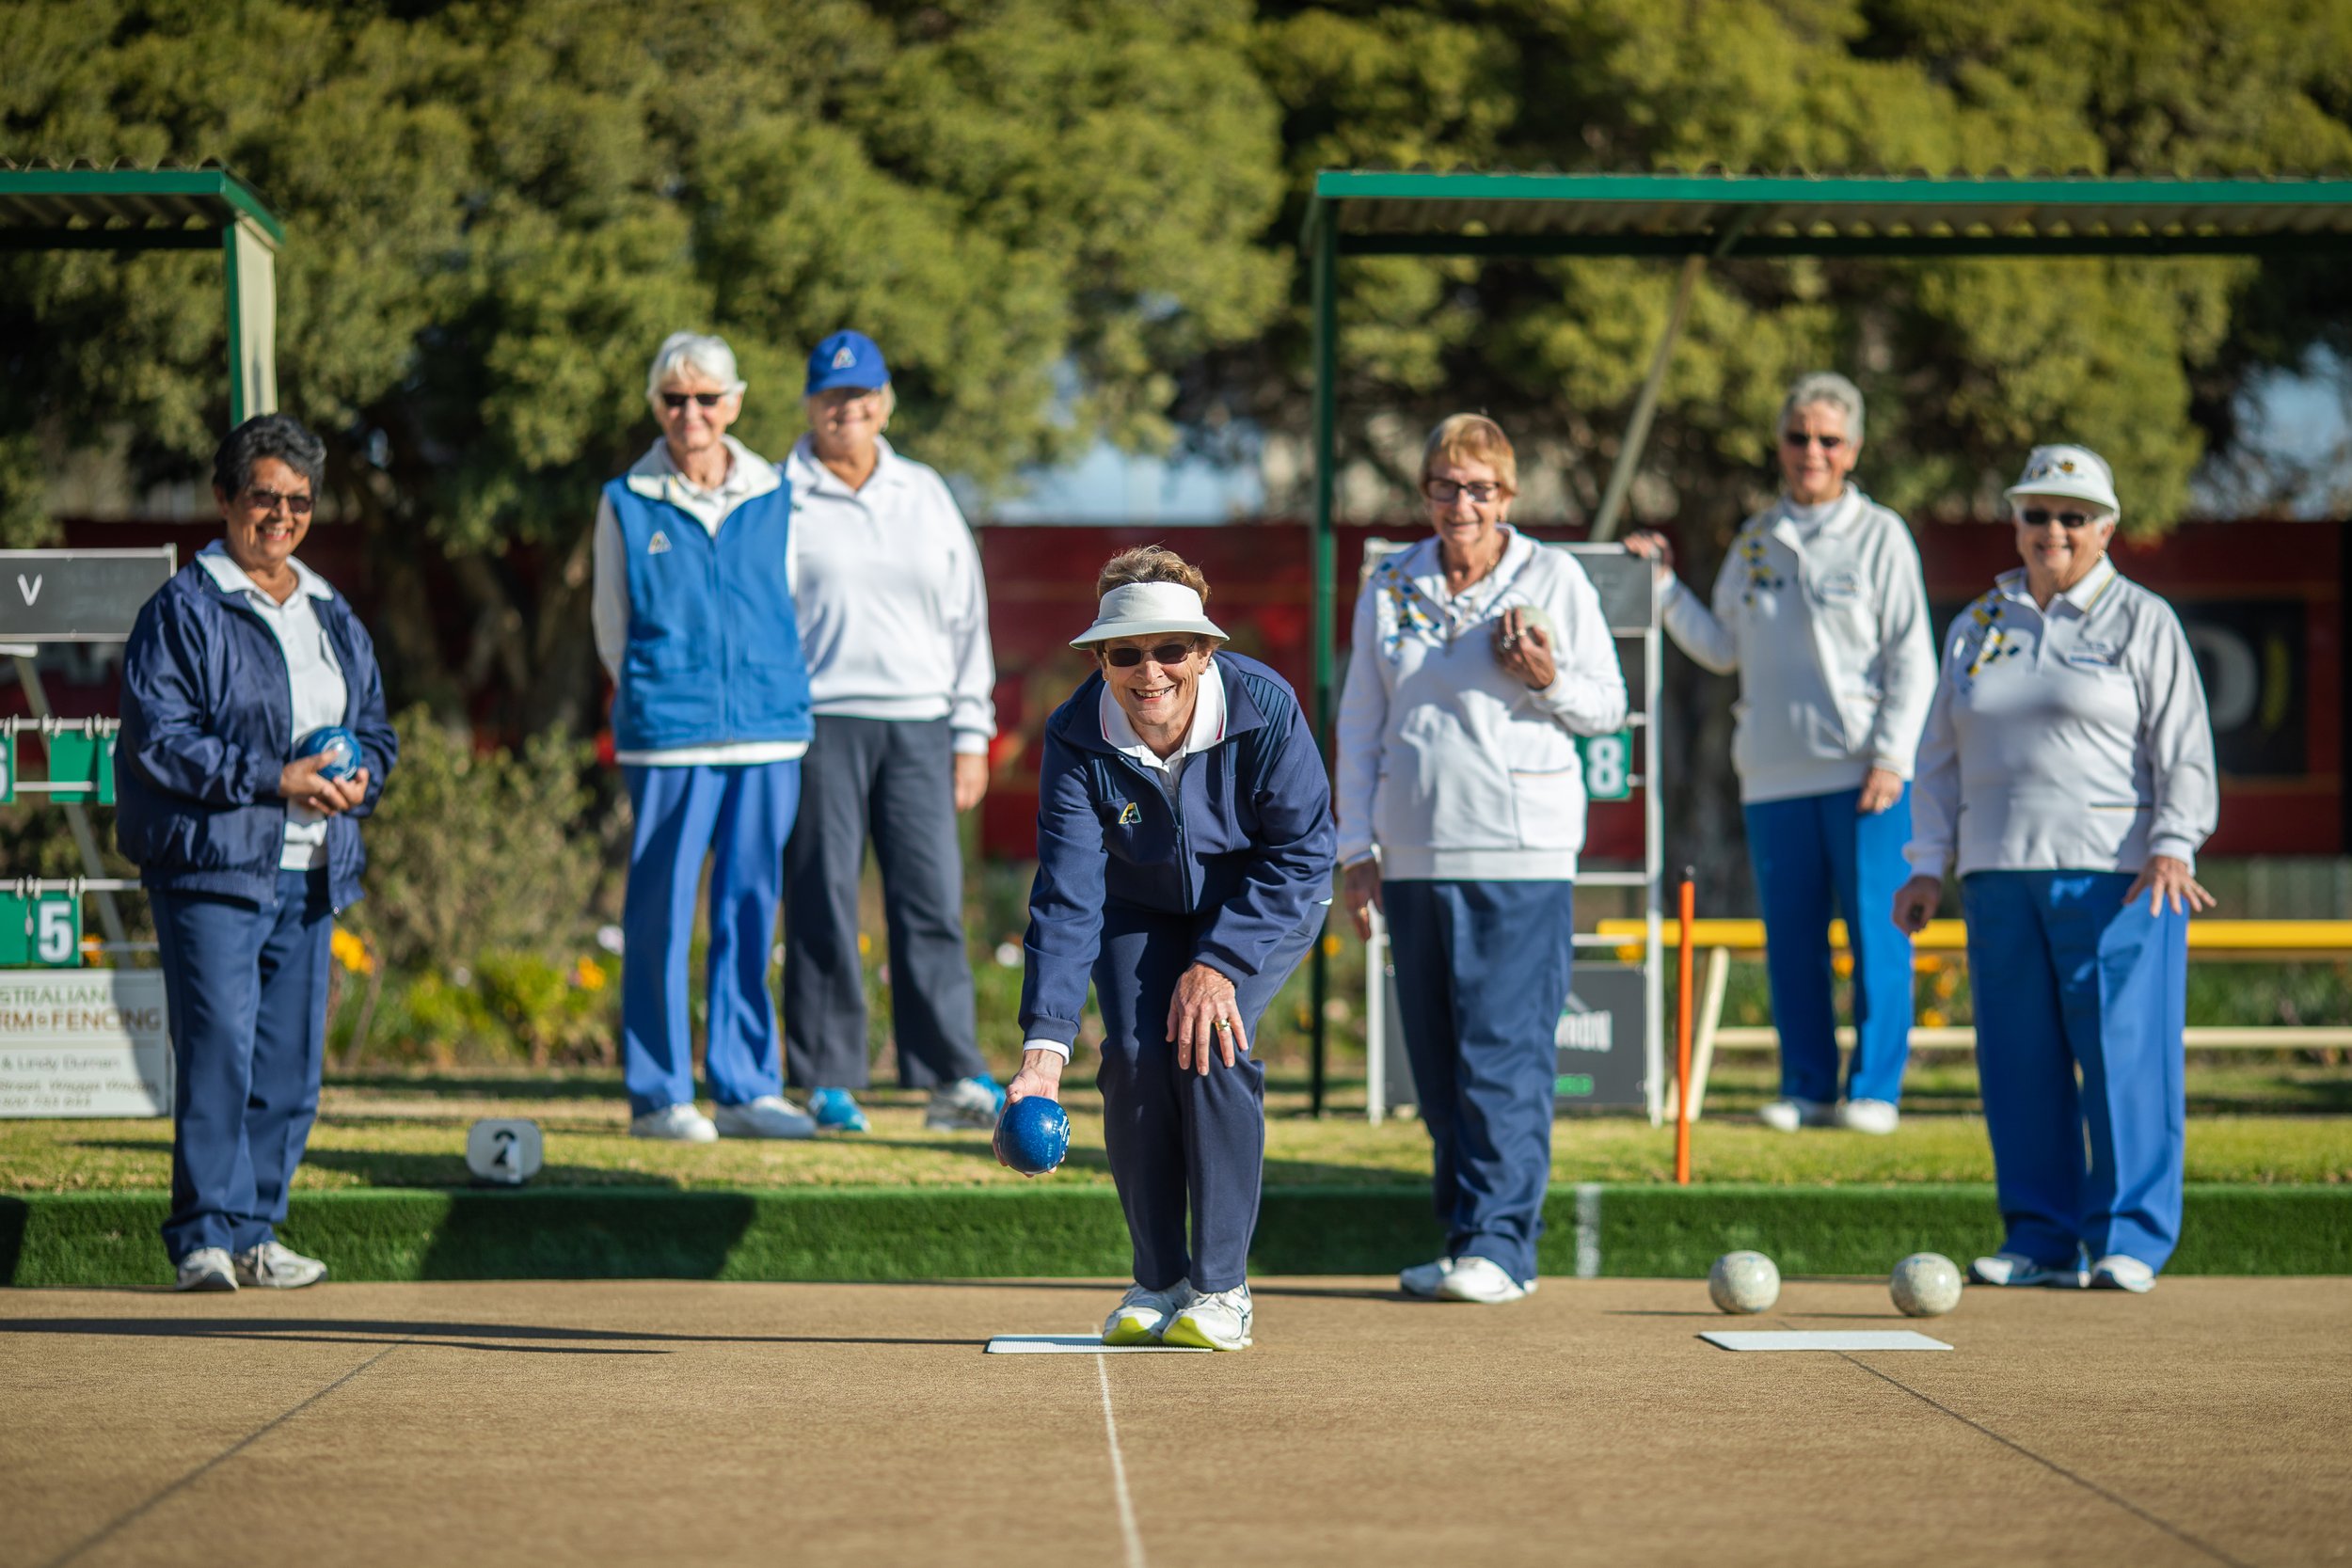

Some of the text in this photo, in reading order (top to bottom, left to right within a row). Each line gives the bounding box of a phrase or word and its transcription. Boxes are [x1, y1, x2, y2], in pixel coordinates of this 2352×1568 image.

[1586, 736, 1626, 797] 8
[39, 900, 73, 963] 5
[492, 1129, 517, 1167] 2
